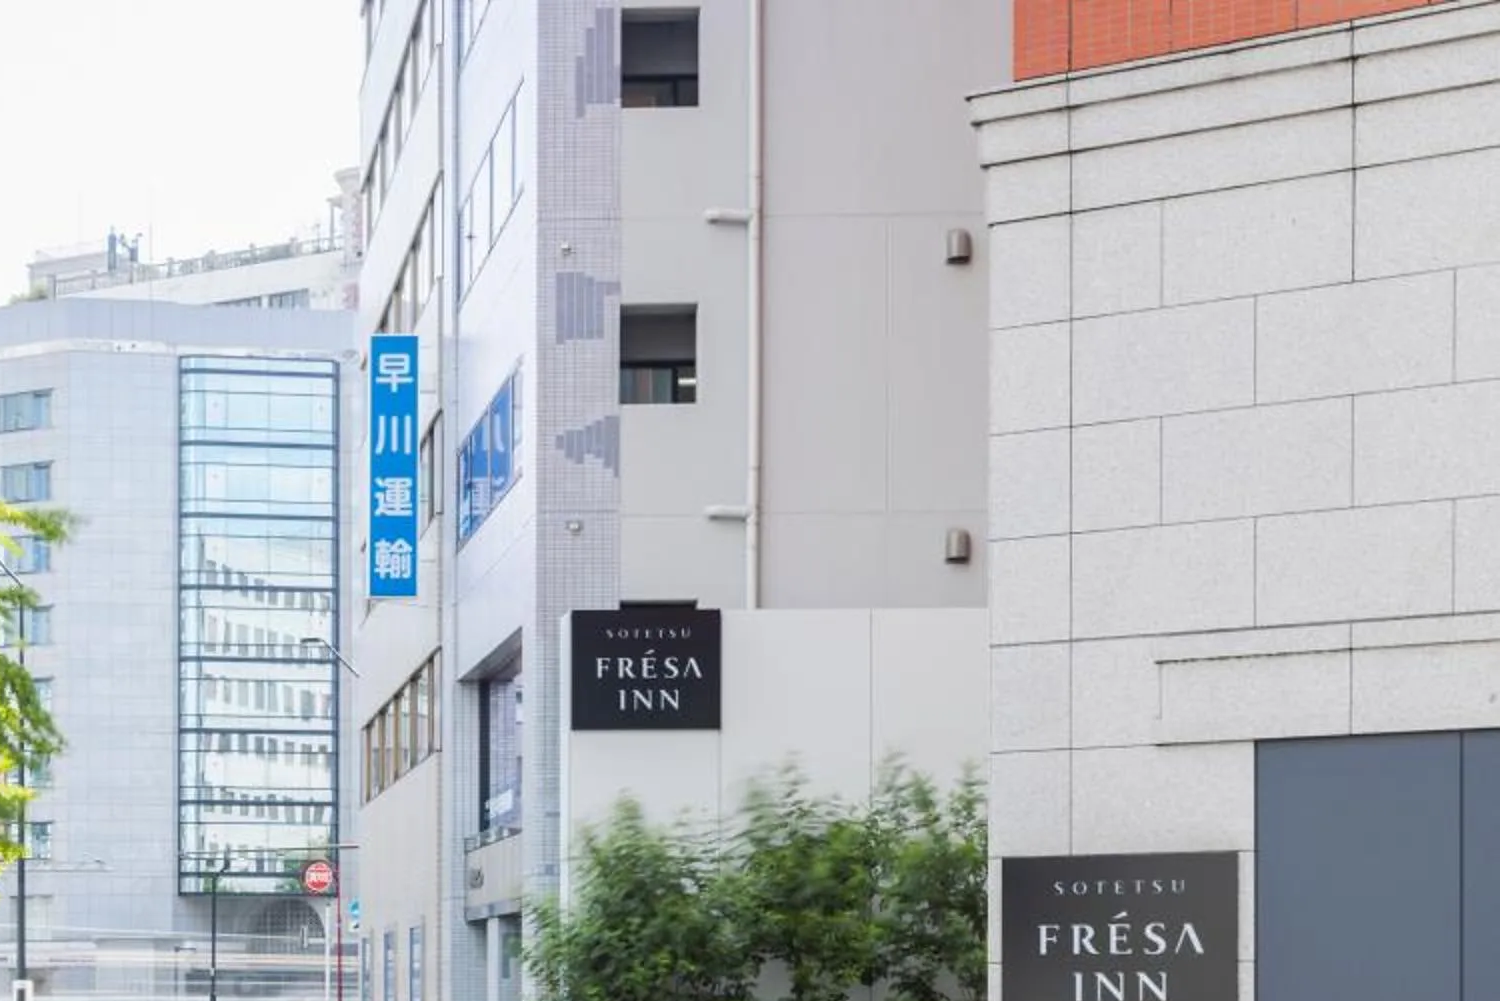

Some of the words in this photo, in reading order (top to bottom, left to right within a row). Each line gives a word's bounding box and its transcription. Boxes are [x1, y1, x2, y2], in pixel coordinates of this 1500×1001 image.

[374, 352, 414, 580] 早川運輸
[606, 627, 692, 639] SOTETSU
[596, 649, 703, 679] FRÉSA
[619, 689, 680, 711] INN
[1054, 880, 1186, 895] SOTETSU
[1037, 911, 1205, 956] FRÉSA
